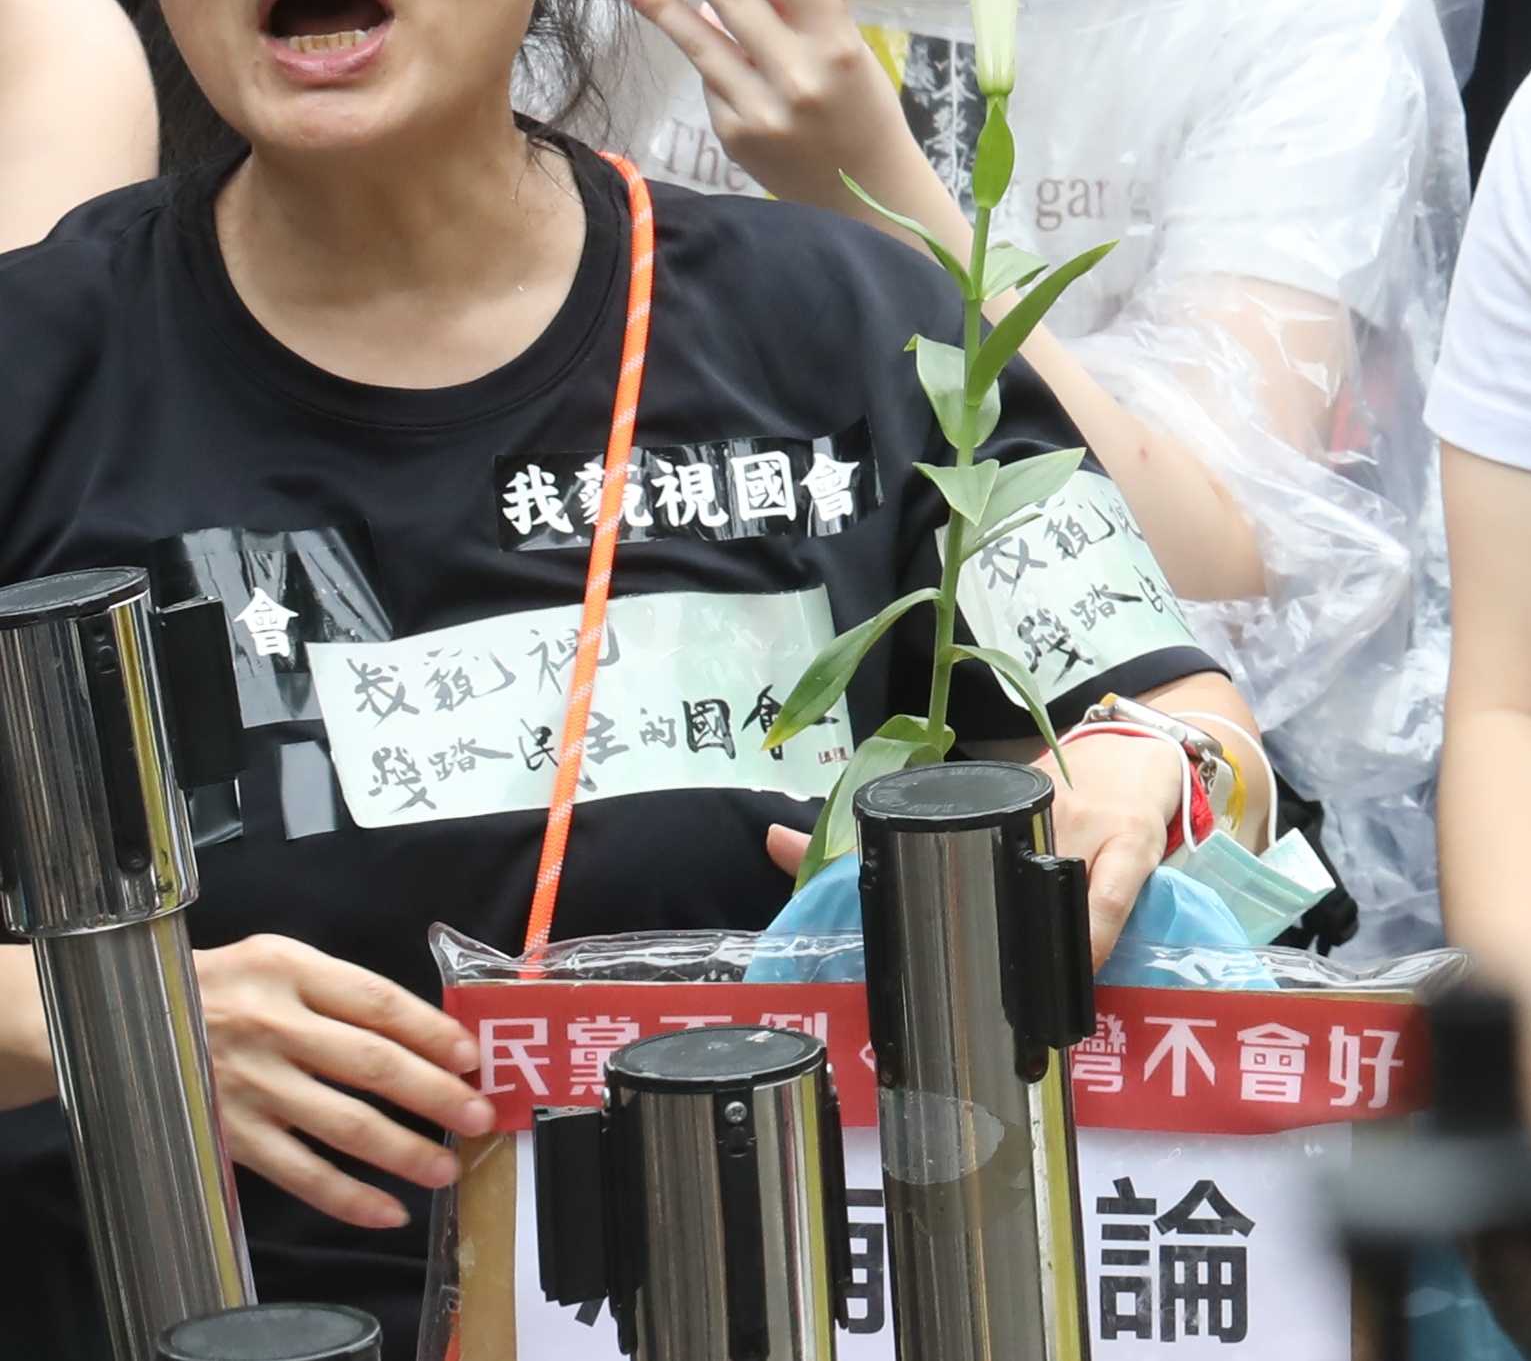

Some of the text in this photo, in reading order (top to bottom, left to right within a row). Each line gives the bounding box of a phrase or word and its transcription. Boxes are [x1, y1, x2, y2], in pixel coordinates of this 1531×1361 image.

[502, 449, 865, 539] 我藐視國會
[234, 585, 300, 661] 會
[1095, 1175, 1257, 1345] 論
